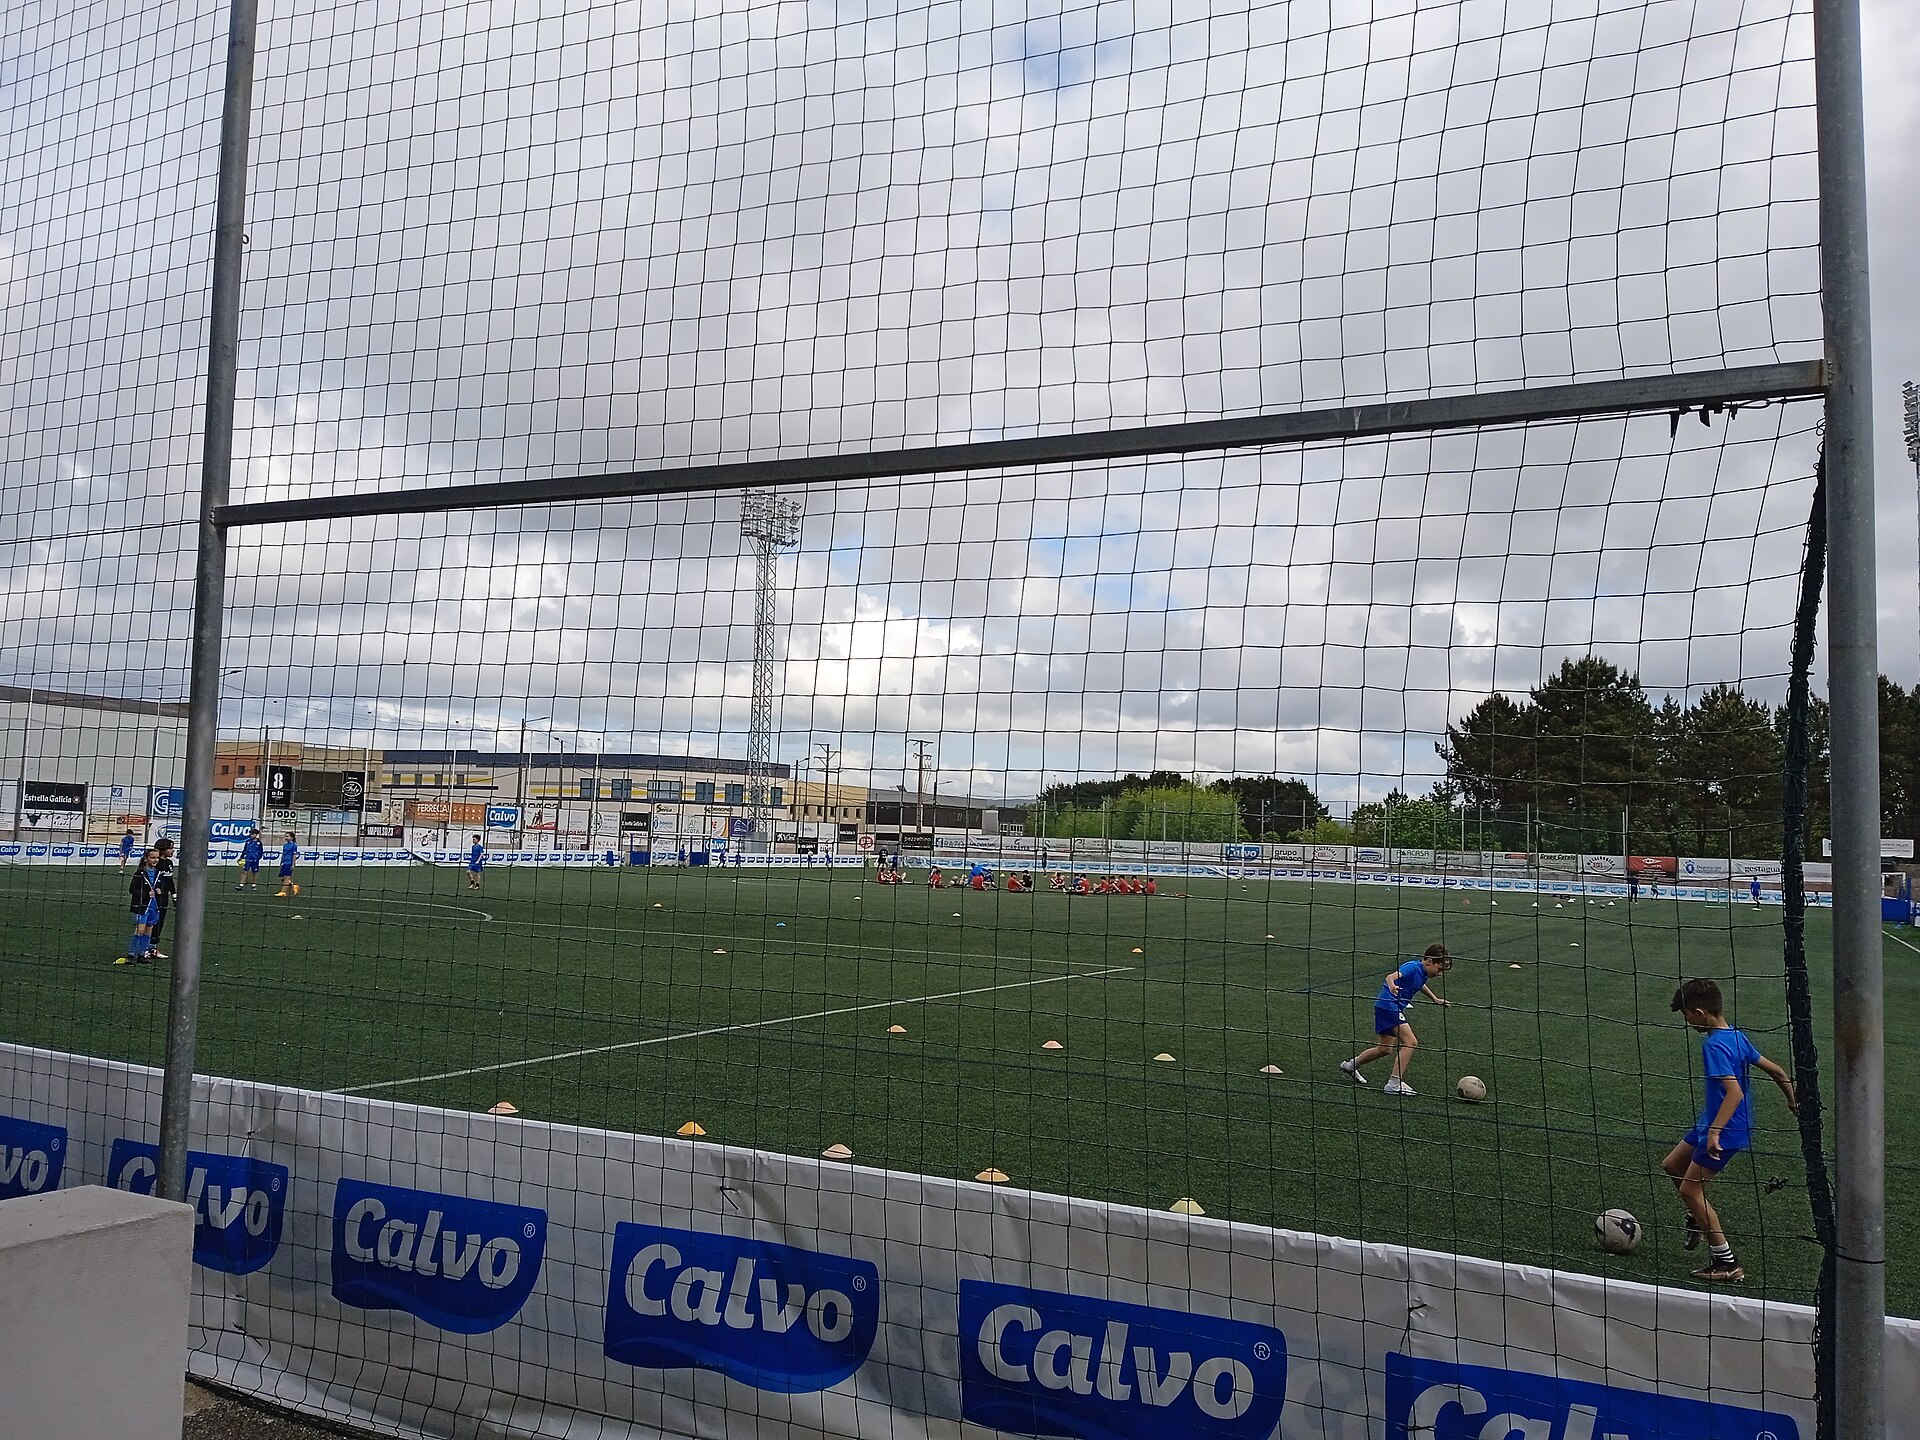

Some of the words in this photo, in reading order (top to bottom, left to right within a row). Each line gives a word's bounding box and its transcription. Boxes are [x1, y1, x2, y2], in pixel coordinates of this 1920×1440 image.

[211, 822, 251, 837] Calvo
[488, 809, 517, 823] Calvo
[1274, 849, 1298, 857] grupo
[117, 1156, 269, 1236] Clvo
[343, 1198, 521, 1290] Calvo
[624, 1243, 854, 1344] Calvo
[977, 1303, 1255, 1420] Calvo
